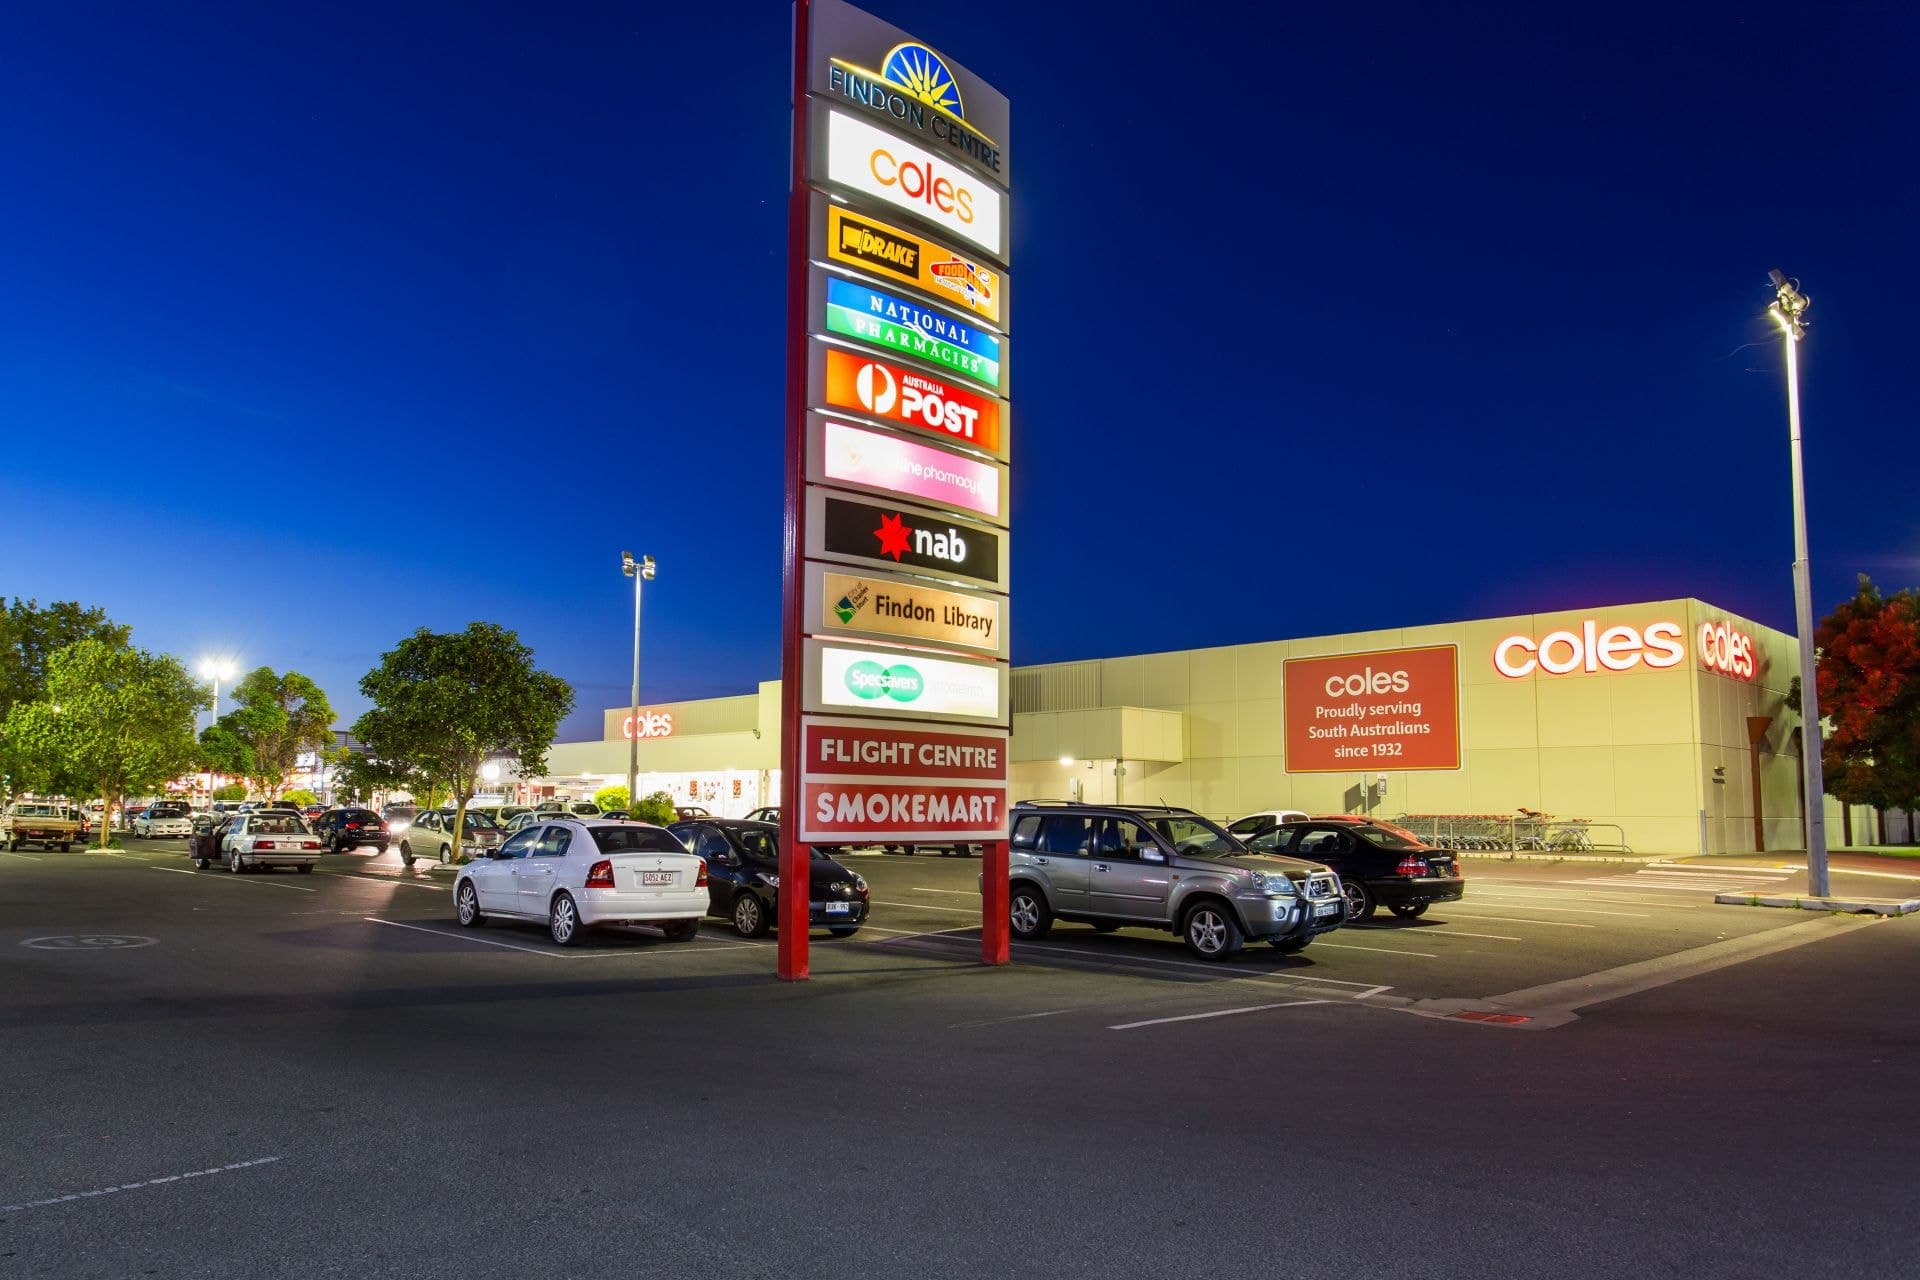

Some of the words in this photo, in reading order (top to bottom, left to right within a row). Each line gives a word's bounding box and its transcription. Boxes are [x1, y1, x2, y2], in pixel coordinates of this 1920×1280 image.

[829, 66, 923, 129] FINDON
[931, 115, 1000, 173] CENTRE
[870, 149, 973, 223] coles
[862, 232, 917, 268] DRAKE
[870, 295, 968, 344] NATIONAL
[855, 318, 979, 373] PHARMACIES
[902, 374, 944, 396] AUSTRALIA
[902, 387, 979, 438] POST
[923, 465, 977, 492] pharmacy
[915, 528, 967, 563] nab
[875, 594, 935, 623] Findon
[943, 605, 993, 638] Library
[1493, 619, 1685, 679] coles
[1702, 619, 1755, 680] coles
[852, 669, 919, 691] Specsavers
[1326, 667, 1409, 697] coles
[624, 710, 672, 739] coles
[1316, 703, 1366, 719] Proudly
[1370, 702, 1421, 717] serving
[1309, 722, 1347, 738] South
[1350, 721, 1430, 737] Australians
[820, 738, 915, 765] FLIGHT
[918, 744, 997, 769] CENTRE
[1334, 744, 1368, 758] since
[1371, 742, 1402, 757] 1932
